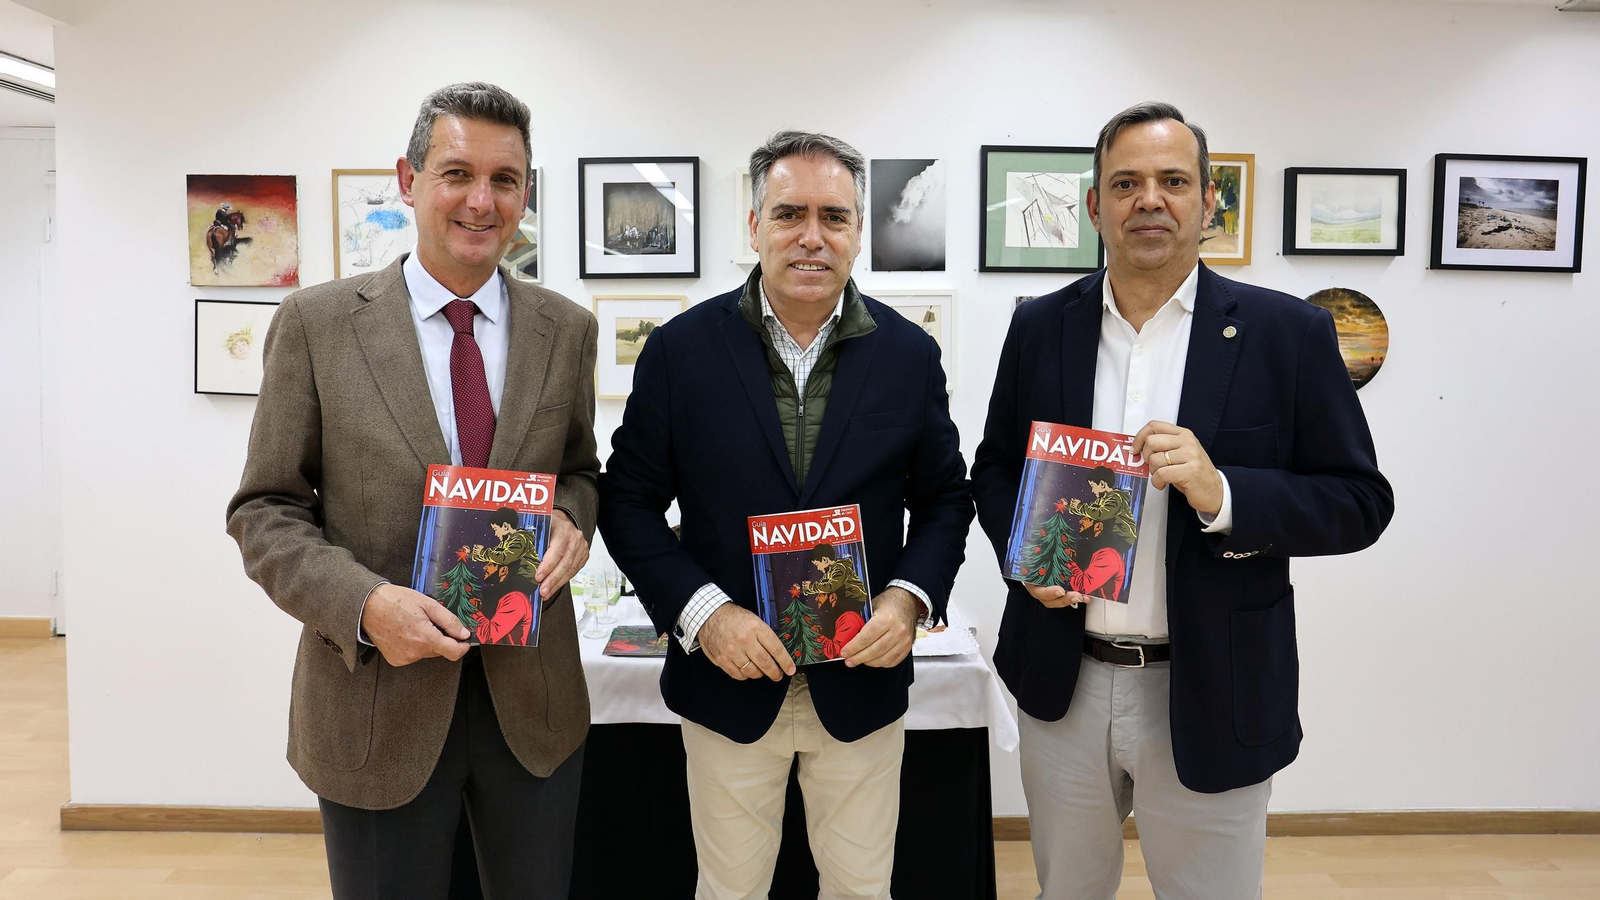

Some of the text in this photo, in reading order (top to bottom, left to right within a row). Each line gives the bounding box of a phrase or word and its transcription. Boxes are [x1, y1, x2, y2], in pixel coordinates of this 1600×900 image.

[1031, 432, 1145, 467] NAVIDAD
[429, 476, 549, 505] NAVIDAD
[752, 516, 856, 546] NAVIDAD
